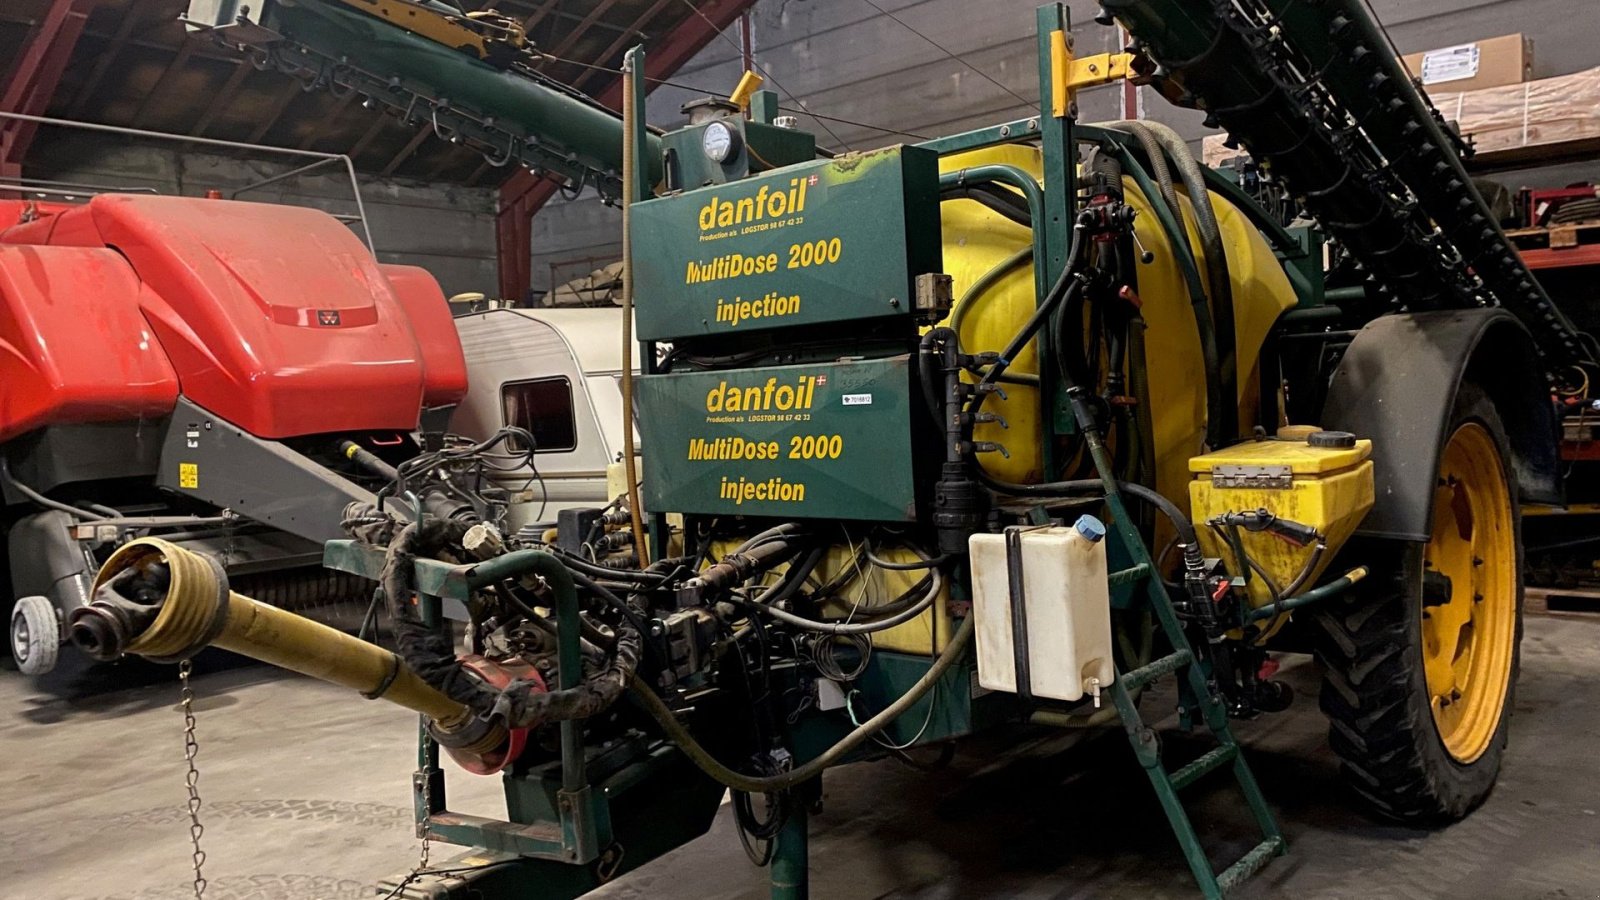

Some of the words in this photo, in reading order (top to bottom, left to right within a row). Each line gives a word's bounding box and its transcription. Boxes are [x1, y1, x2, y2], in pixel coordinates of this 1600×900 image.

[699, 177, 808, 231] danfoil
[699, 231, 729, 242] Production
[686, 252, 778, 285] MultiDose
[787, 237, 842, 270] 2000
[715, 291, 801, 327] injection
[706, 375, 816, 413] danfoil
[706, 415, 736, 423] Production
[785, 413, 793, 421] 67
[793, 413, 802, 421] 42
[687, 436, 779, 460] MultiDose
[788, 434, 843, 459] 2000
[719, 475, 806, 506] injection
